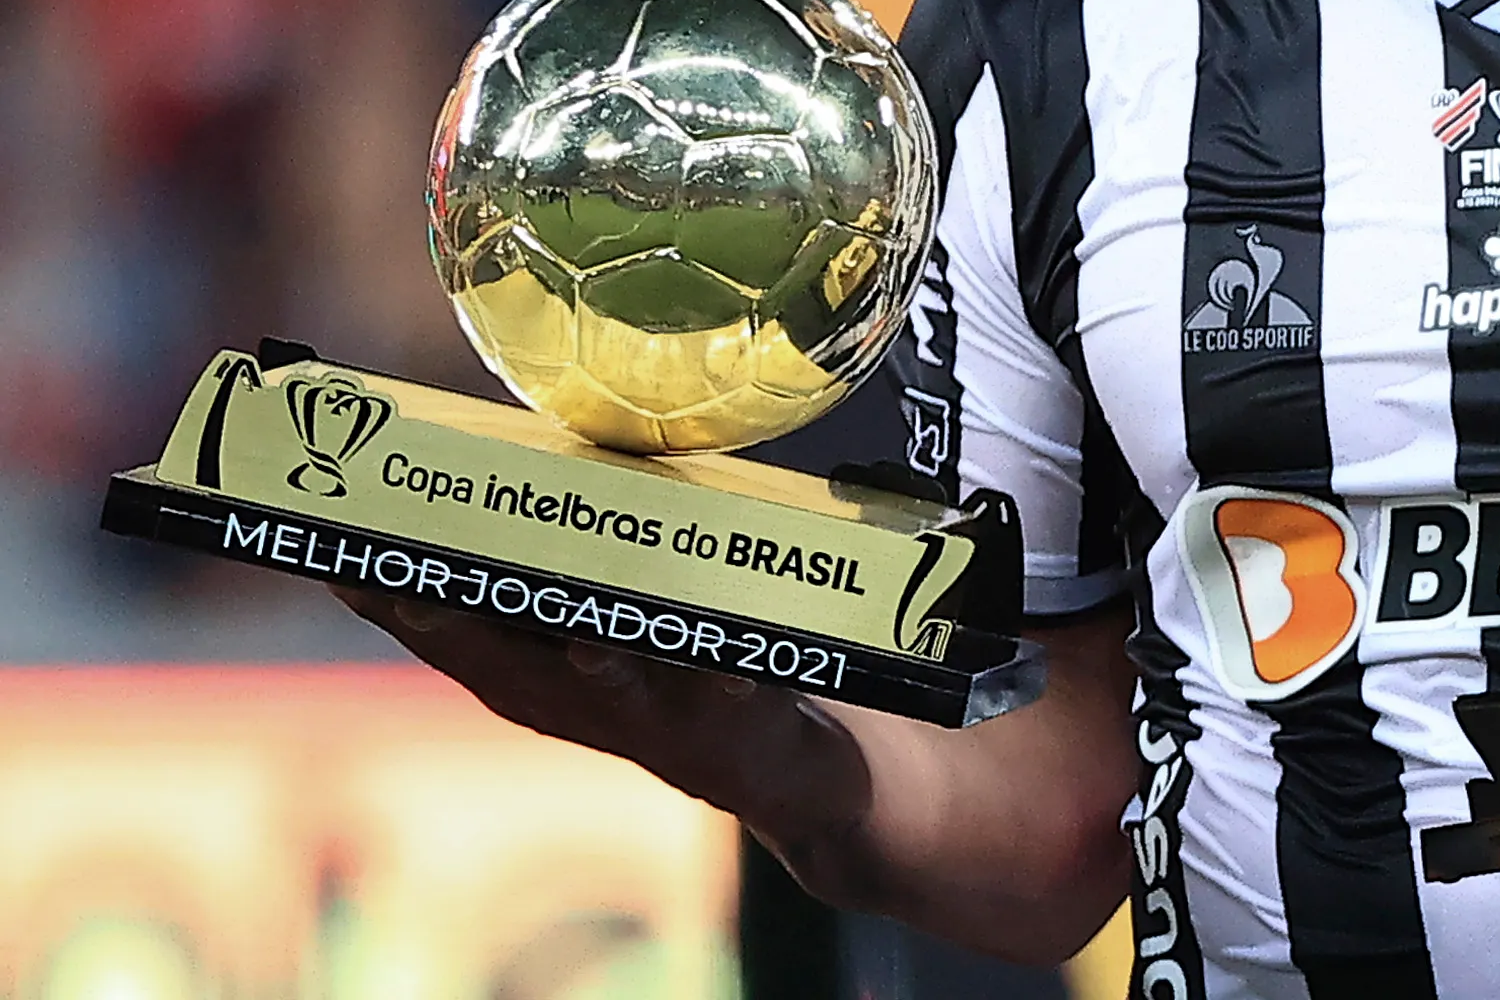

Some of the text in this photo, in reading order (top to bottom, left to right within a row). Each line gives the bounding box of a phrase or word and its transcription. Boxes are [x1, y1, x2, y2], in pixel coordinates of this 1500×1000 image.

[1183, 326, 1314, 352] LE COQ SPORTIF
[382, 452, 866, 595] Copa intelbras do BRASIL
[223, 513, 848, 690] MELHOR JOGADOR 2021
